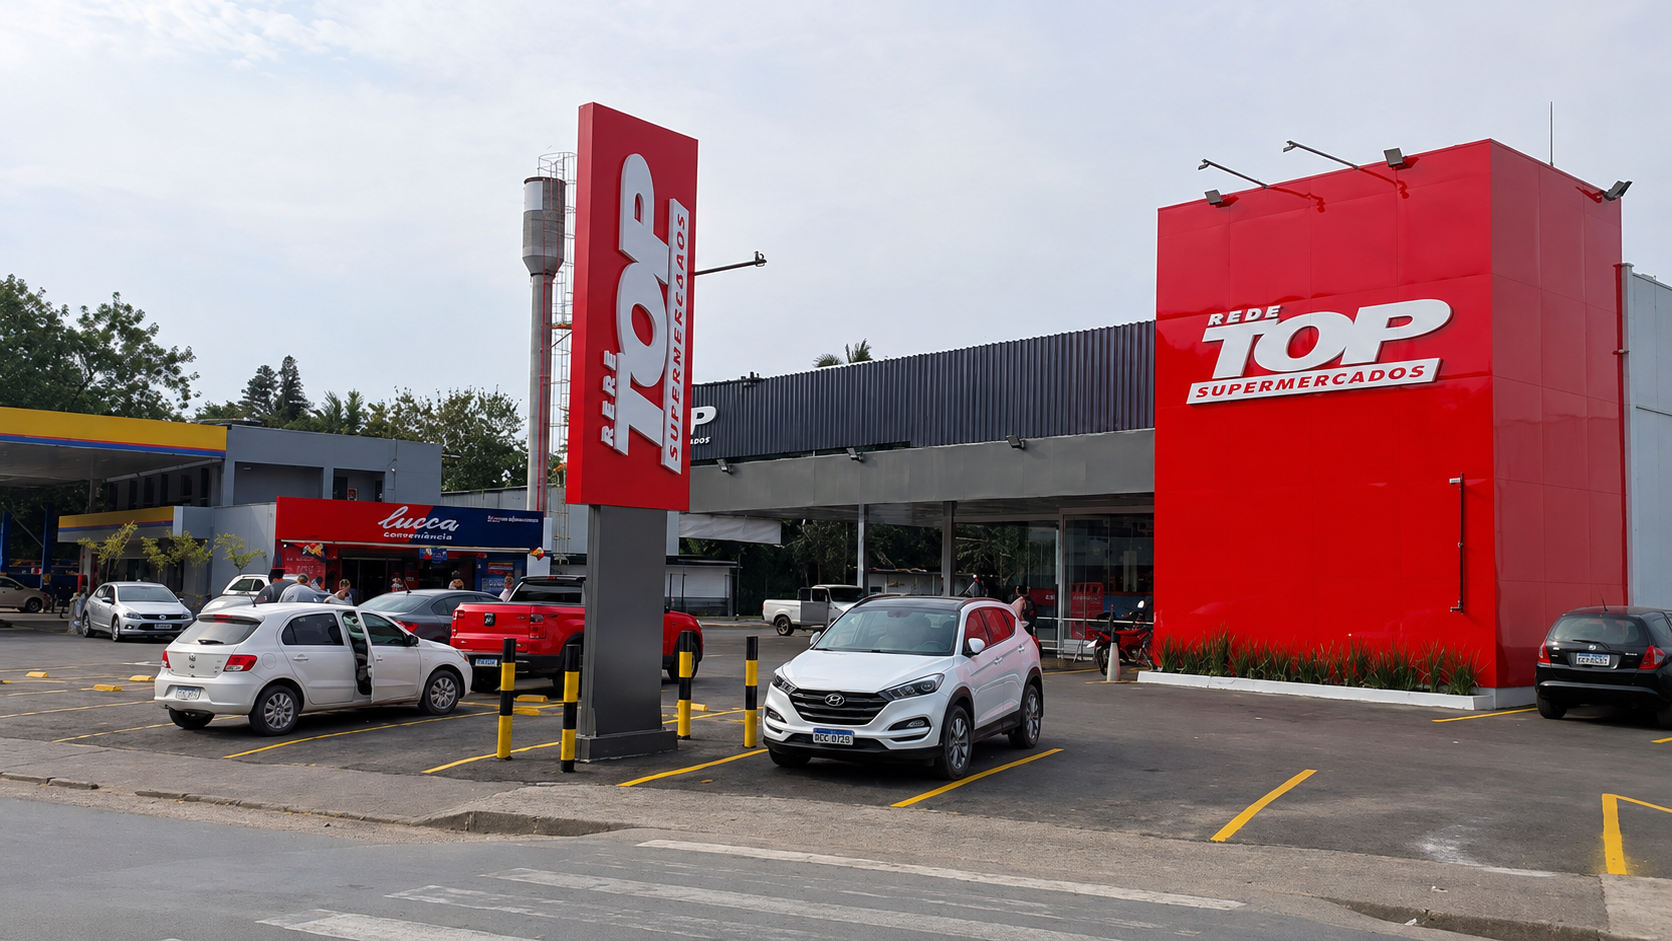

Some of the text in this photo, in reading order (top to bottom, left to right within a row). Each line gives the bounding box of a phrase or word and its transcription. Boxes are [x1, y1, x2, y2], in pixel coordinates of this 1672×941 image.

[616, 153, 669, 456] TOP
[1207, 305, 1282, 326] REDE
[1202, 299, 1453, 379] TOP
[1196, 364, 1426, 398] SUPERMERCADOS
[378, 506, 459, 531] lucca
